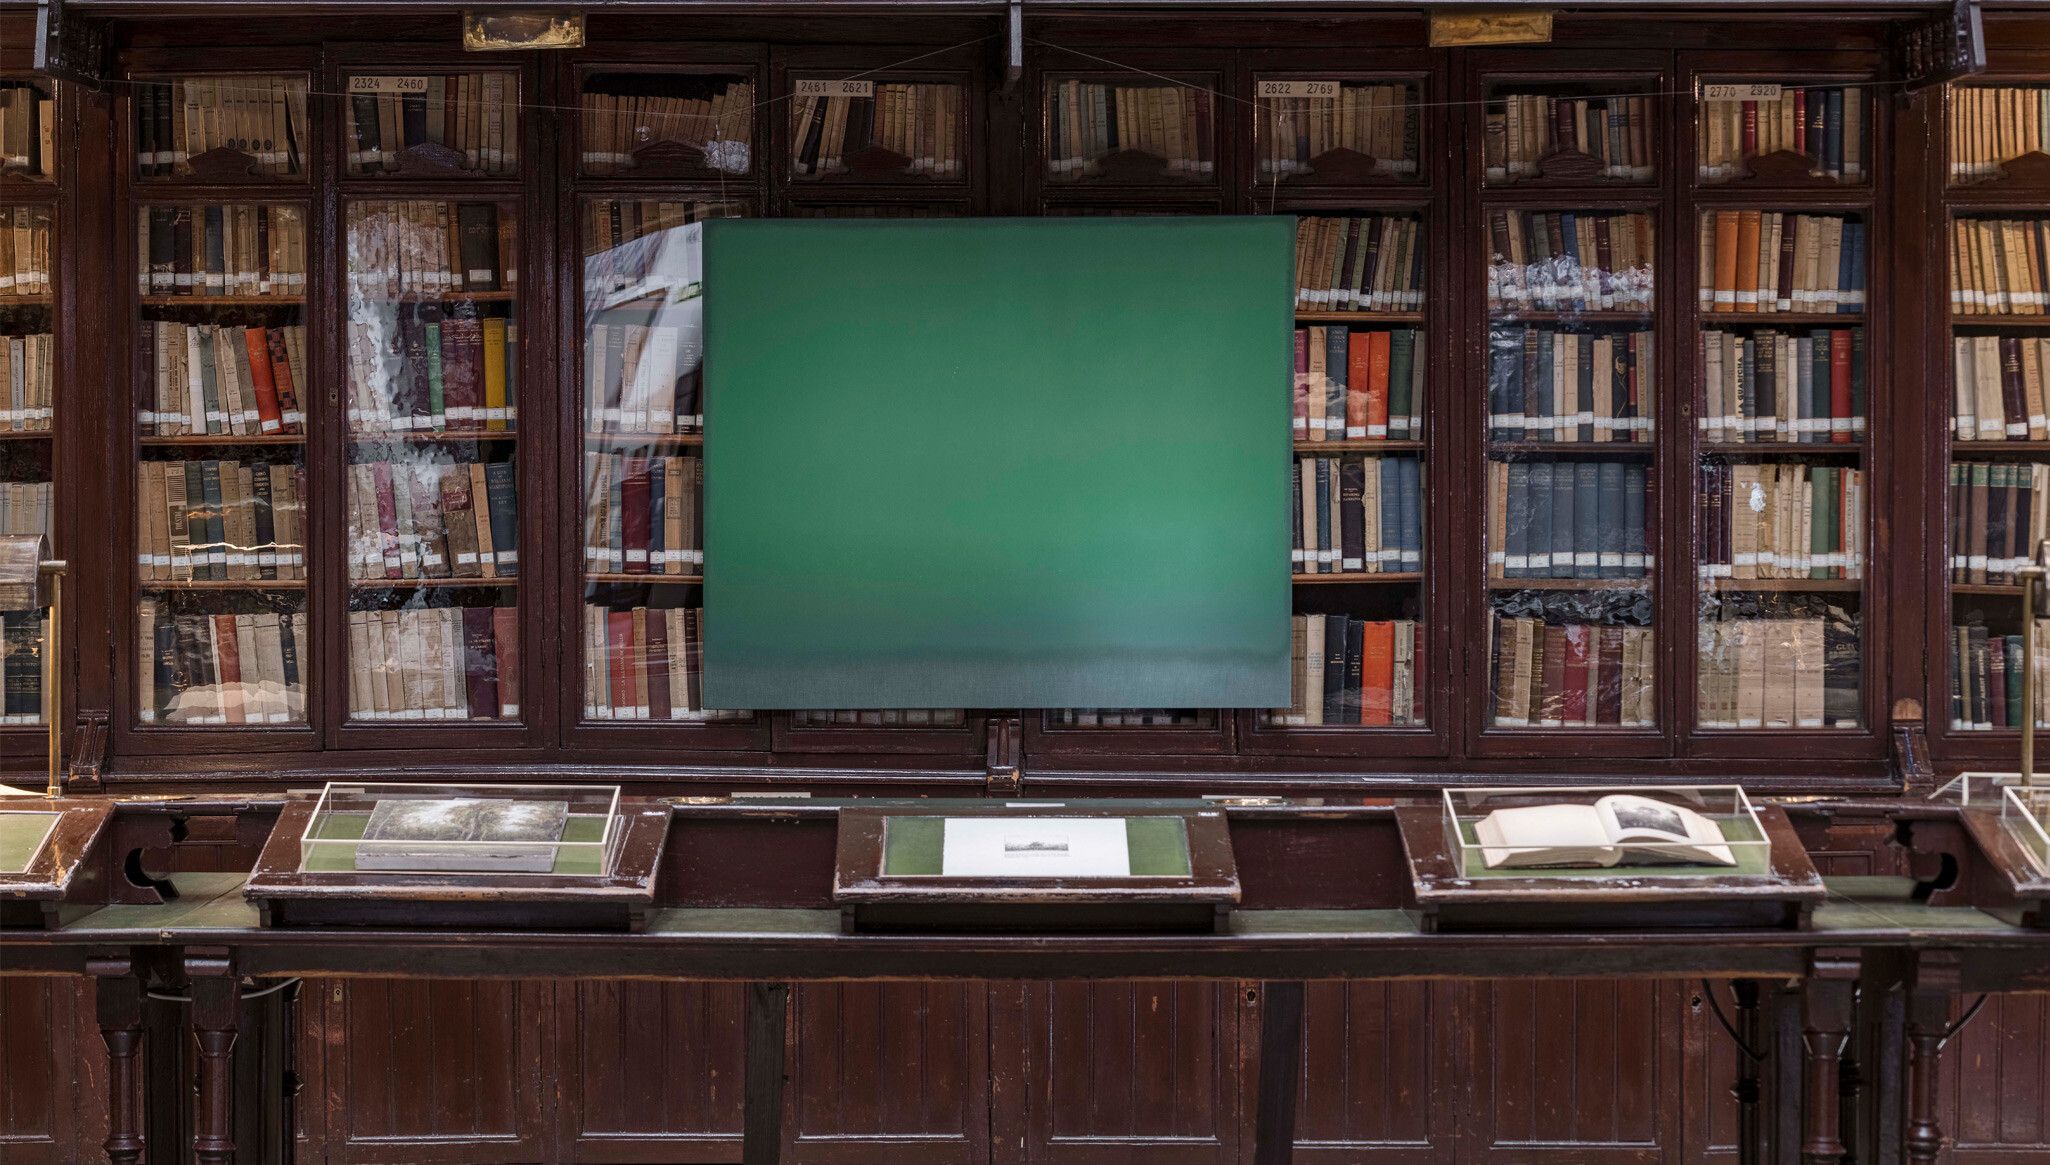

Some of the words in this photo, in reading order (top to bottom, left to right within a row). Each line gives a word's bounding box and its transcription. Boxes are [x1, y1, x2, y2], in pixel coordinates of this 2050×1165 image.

[354, 78, 380, 89] 2324
[397, 78, 425, 90] 2460
[842, 82, 869, 93] 2621
[1265, 83, 1291, 94] 2622
[1306, 83, 1333, 95] 2769
[1710, 86, 1736, 98] 2770
[1750, 84, 1777, 97] 2920
